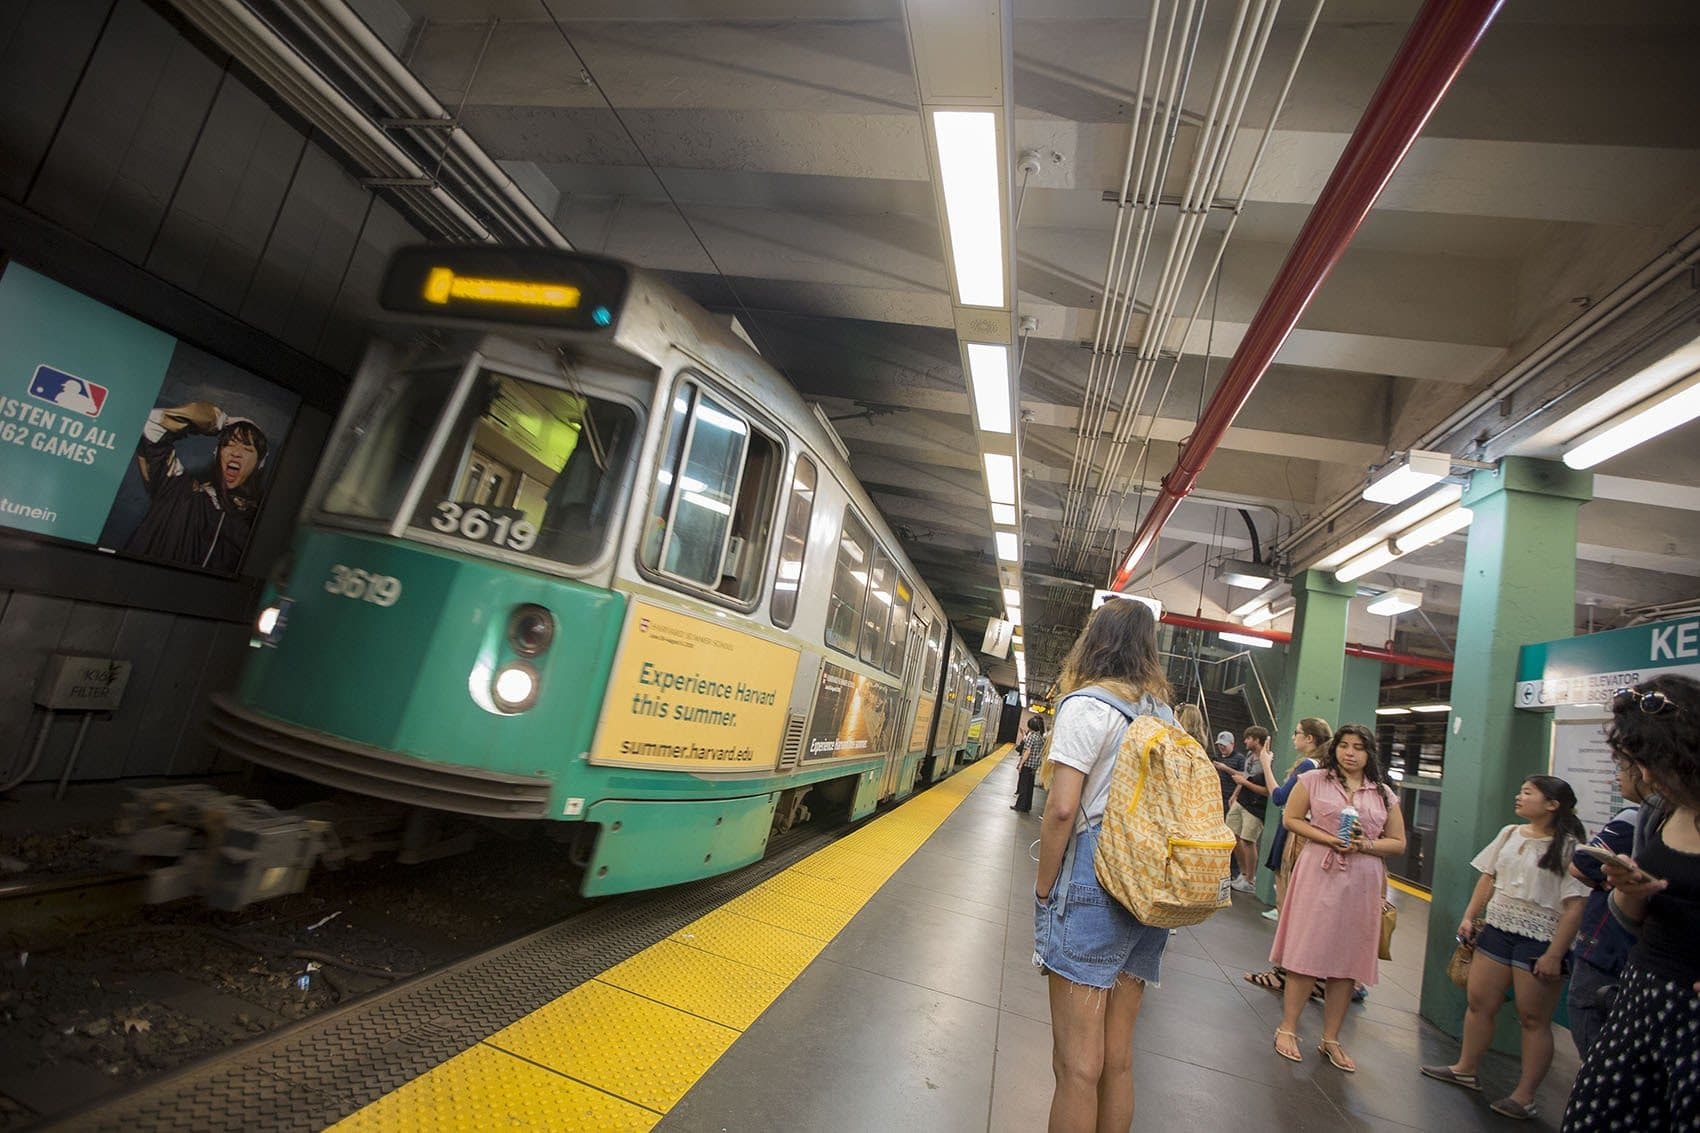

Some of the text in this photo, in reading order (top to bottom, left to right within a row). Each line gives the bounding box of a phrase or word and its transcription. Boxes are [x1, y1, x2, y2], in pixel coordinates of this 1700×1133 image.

[31, 432, 97, 465] GAMES
[59, 416, 84, 438] TO
[85, 427, 116, 450] ALL
[0, 498, 57, 522] tunein
[430, 500, 539, 551] 3619
[324, 564, 402, 608] 3619
[70, 686, 110, 698] FILTER
[639, 662, 777, 706] Experience Harvard
[1589, 673, 1641, 688] ELEVATOR
[632, 693, 737, 727] this summer.
[620, 740, 755, 762] summer.harvard.edu
